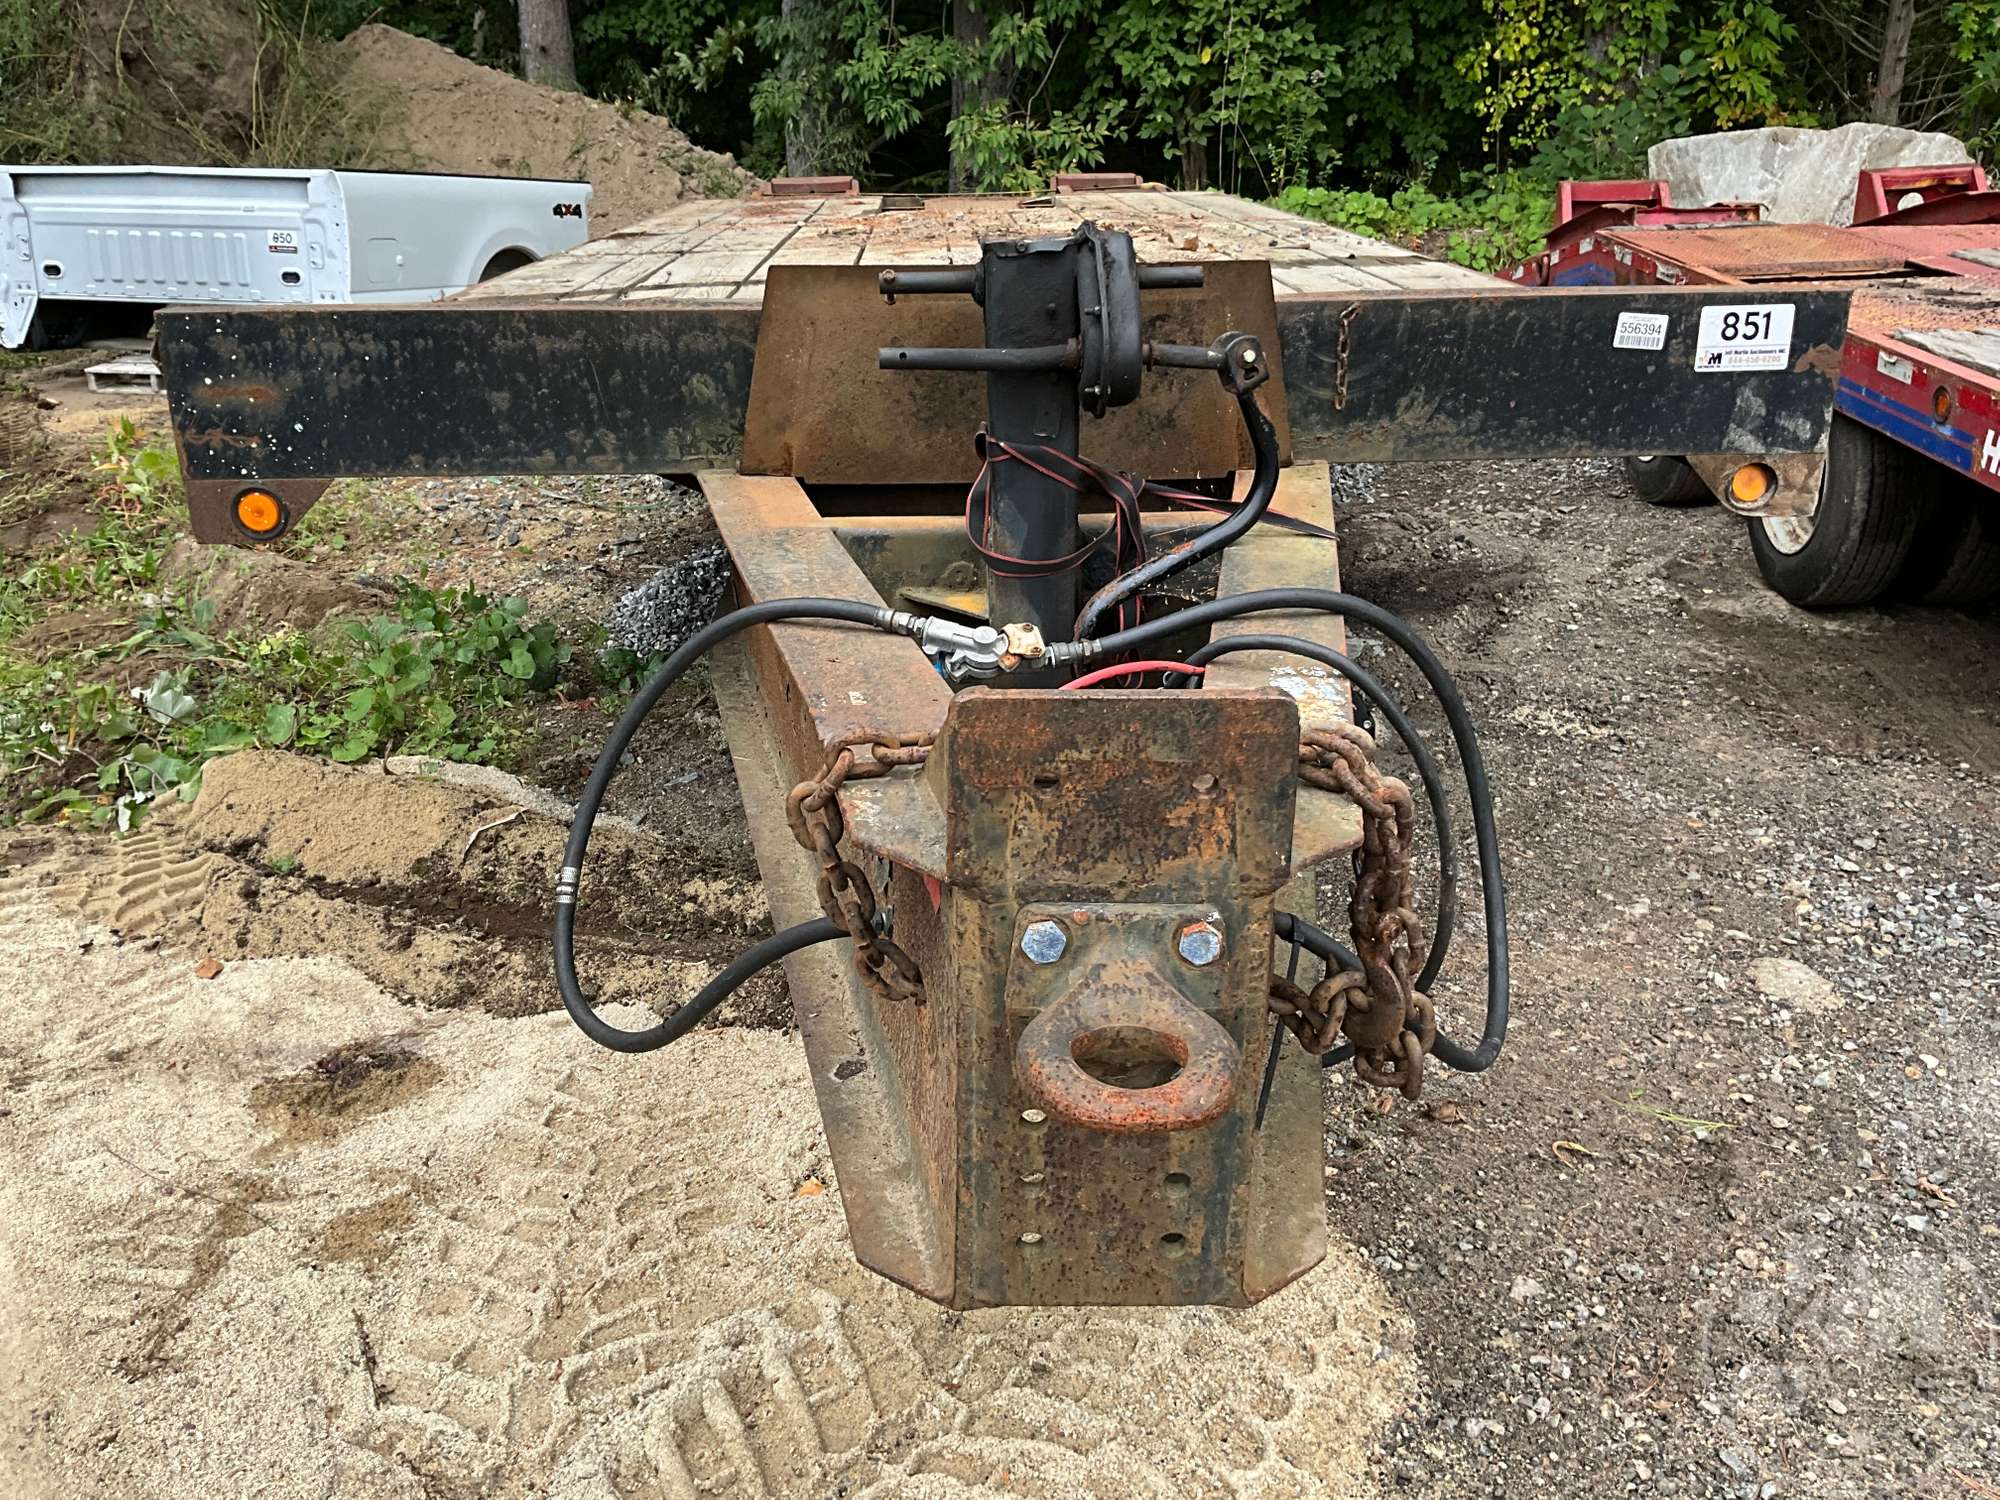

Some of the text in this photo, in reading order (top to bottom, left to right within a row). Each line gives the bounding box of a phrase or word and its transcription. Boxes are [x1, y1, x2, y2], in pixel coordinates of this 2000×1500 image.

[272, 232, 293, 244] 850
[1620, 322, 1662, 335] 556394
[1721, 310, 1772, 341] 851
[1980, 428, 2000, 477] H
